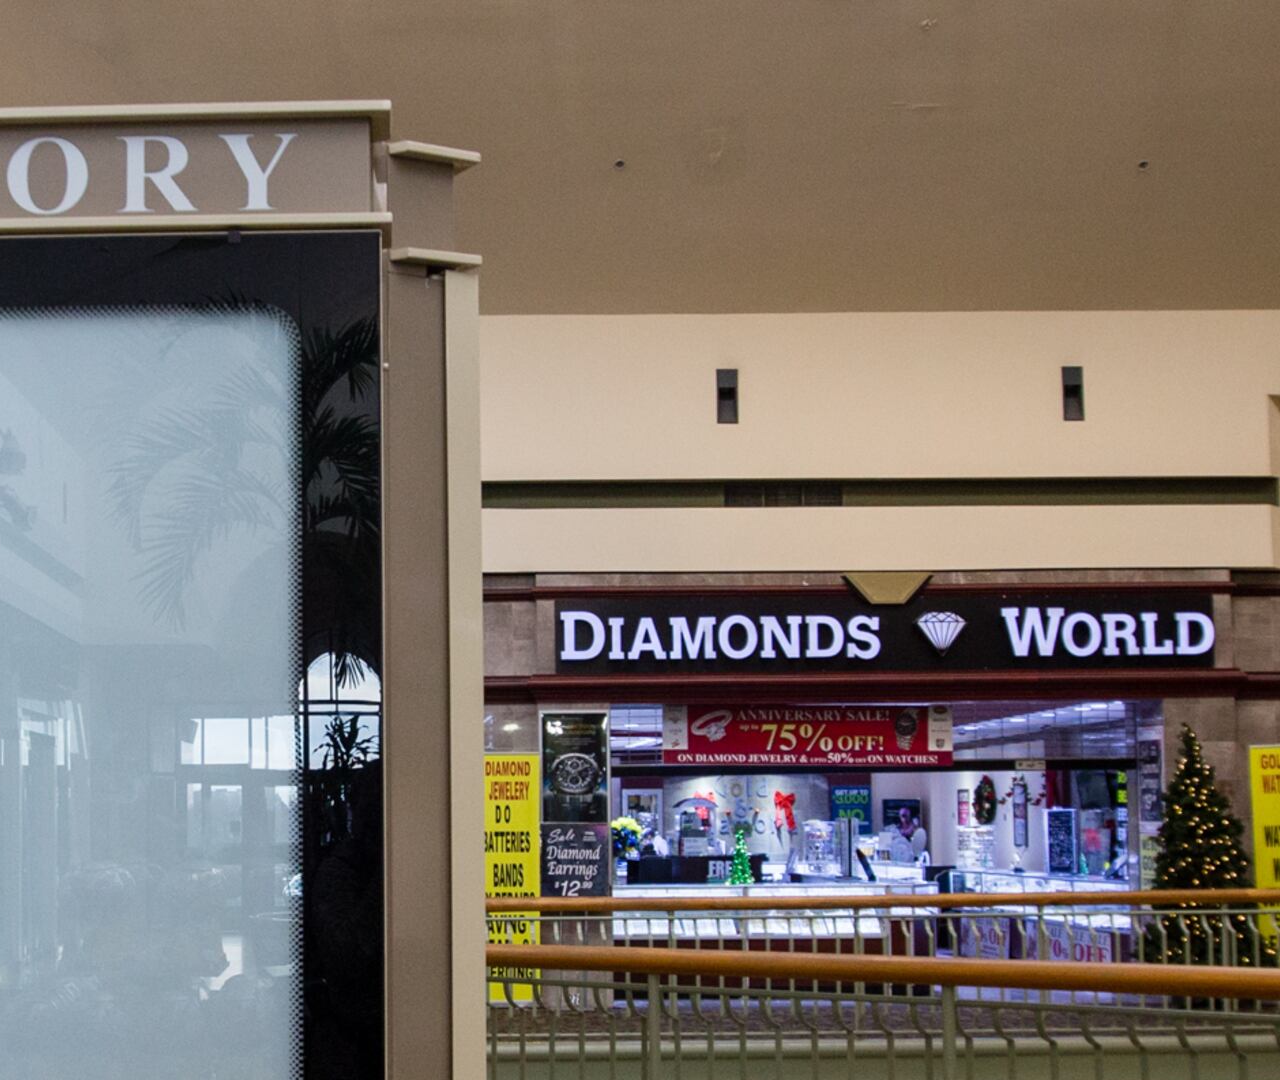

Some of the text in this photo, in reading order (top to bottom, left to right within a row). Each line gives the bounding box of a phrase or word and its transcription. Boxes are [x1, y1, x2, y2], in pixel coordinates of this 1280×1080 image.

[559, 607, 1216, 661] DIAMONDS WORLD
[736, 709, 891, 722] ANNIVERSARY SALE!
[760, 723, 833, 752] 75%
[837, 735, 885, 752] OFF!
[485, 761, 531, 776] DIAMOND
[677, 753, 695, 763] ON
[695, 753, 746, 764] DIAMOND
[748, 754, 797, 764] JEWELRY
[799, 754, 809, 764] &
[827, 752, 854, 765] 50%
[867, 753, 885, 764] ON
[885, 754, 939, 765] WATCHES!
[489, 781, 530, 801] JEWELERY
[495, 804, 511, 824] DO
[547, 828, 576, 844] Sale
[546, 844, 602, 861] Diamond
[493, 863, 524, 888] BANDS
[547, 861, 598, 881] Earrings
